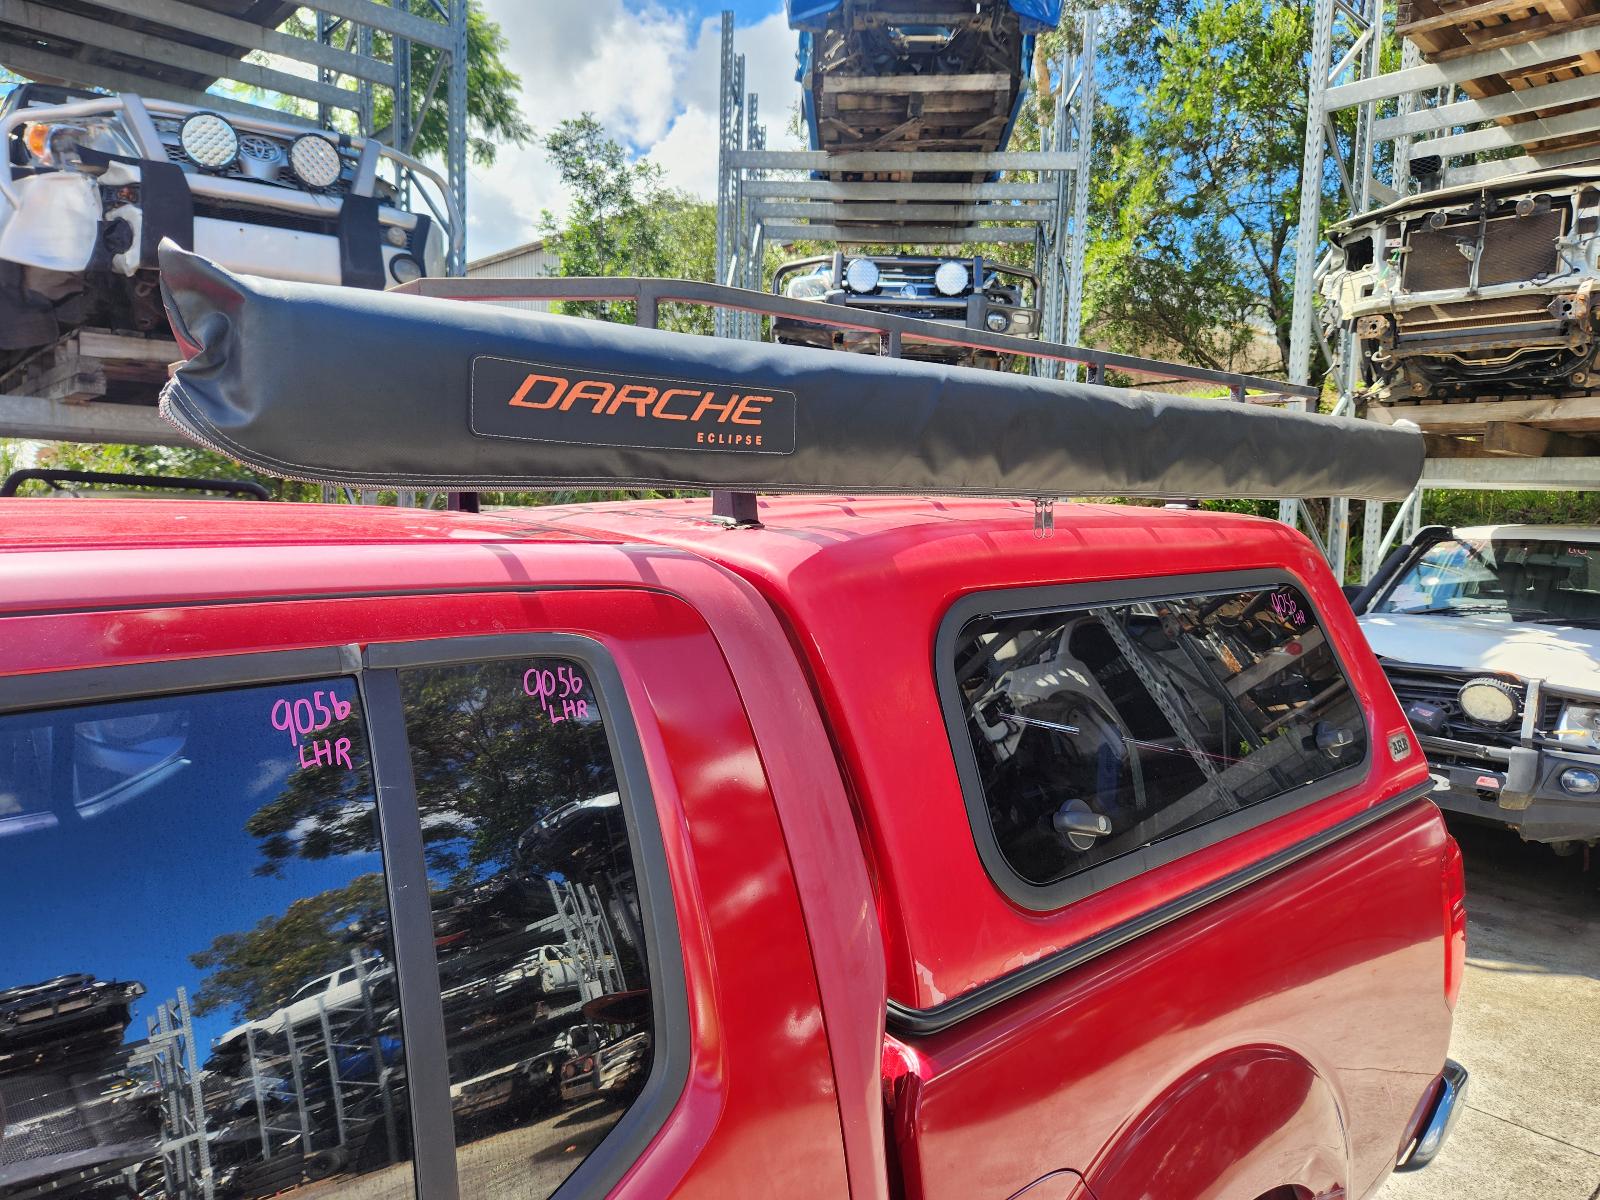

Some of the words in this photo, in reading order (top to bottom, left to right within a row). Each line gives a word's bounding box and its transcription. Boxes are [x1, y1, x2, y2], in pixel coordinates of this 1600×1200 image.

[508, 373, 774, 425] DARCHE
[696, 432, 763, 446] ECLIPSE
[523, 664, 583, 711] 9056
[271, 690, 351, 747] 9056
[548, 699, 589, 724] LHR
[299, 737, 353, 770] LHR
